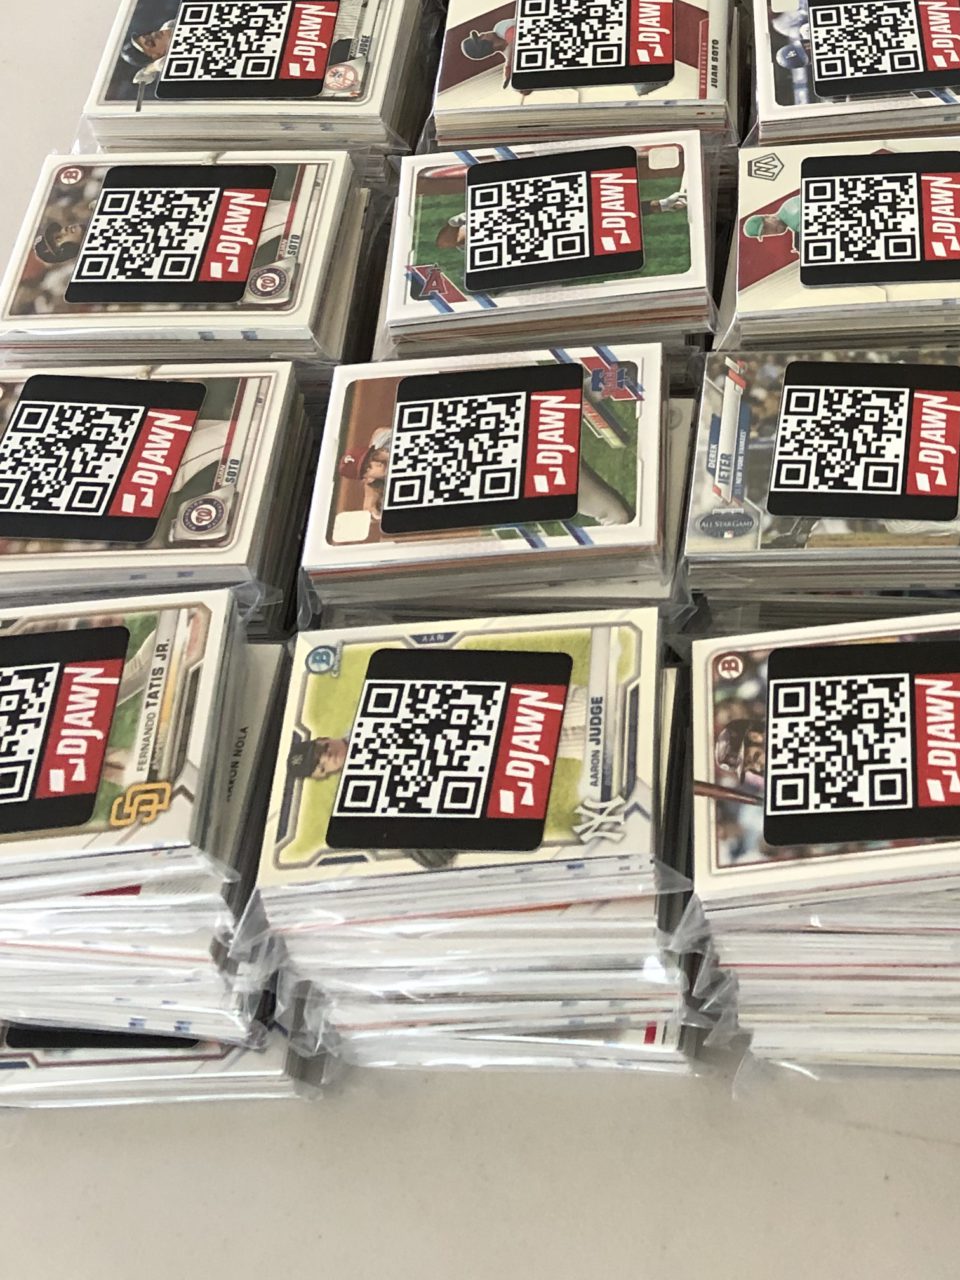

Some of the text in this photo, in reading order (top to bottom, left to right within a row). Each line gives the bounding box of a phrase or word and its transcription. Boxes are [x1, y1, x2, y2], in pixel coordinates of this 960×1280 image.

[357, 35, 370, 56] JUDGE
[710, 39, 719, 89] JUAN SOTO
[287, 234, 300, 256] SOTO
[225, 459, 240, 483] SOTO
[708, 443, 718, 469] DEREK
[717, 453, 732, 486] JETER
[156, 638, 170, 662] JR.
[144, 667, 164, 710] TATIS
[136, 712, 156, 772] FERNANDO
[231, 726, 249, 757] NOLA
[589, 696, 603, 787] AARON JUDGE
